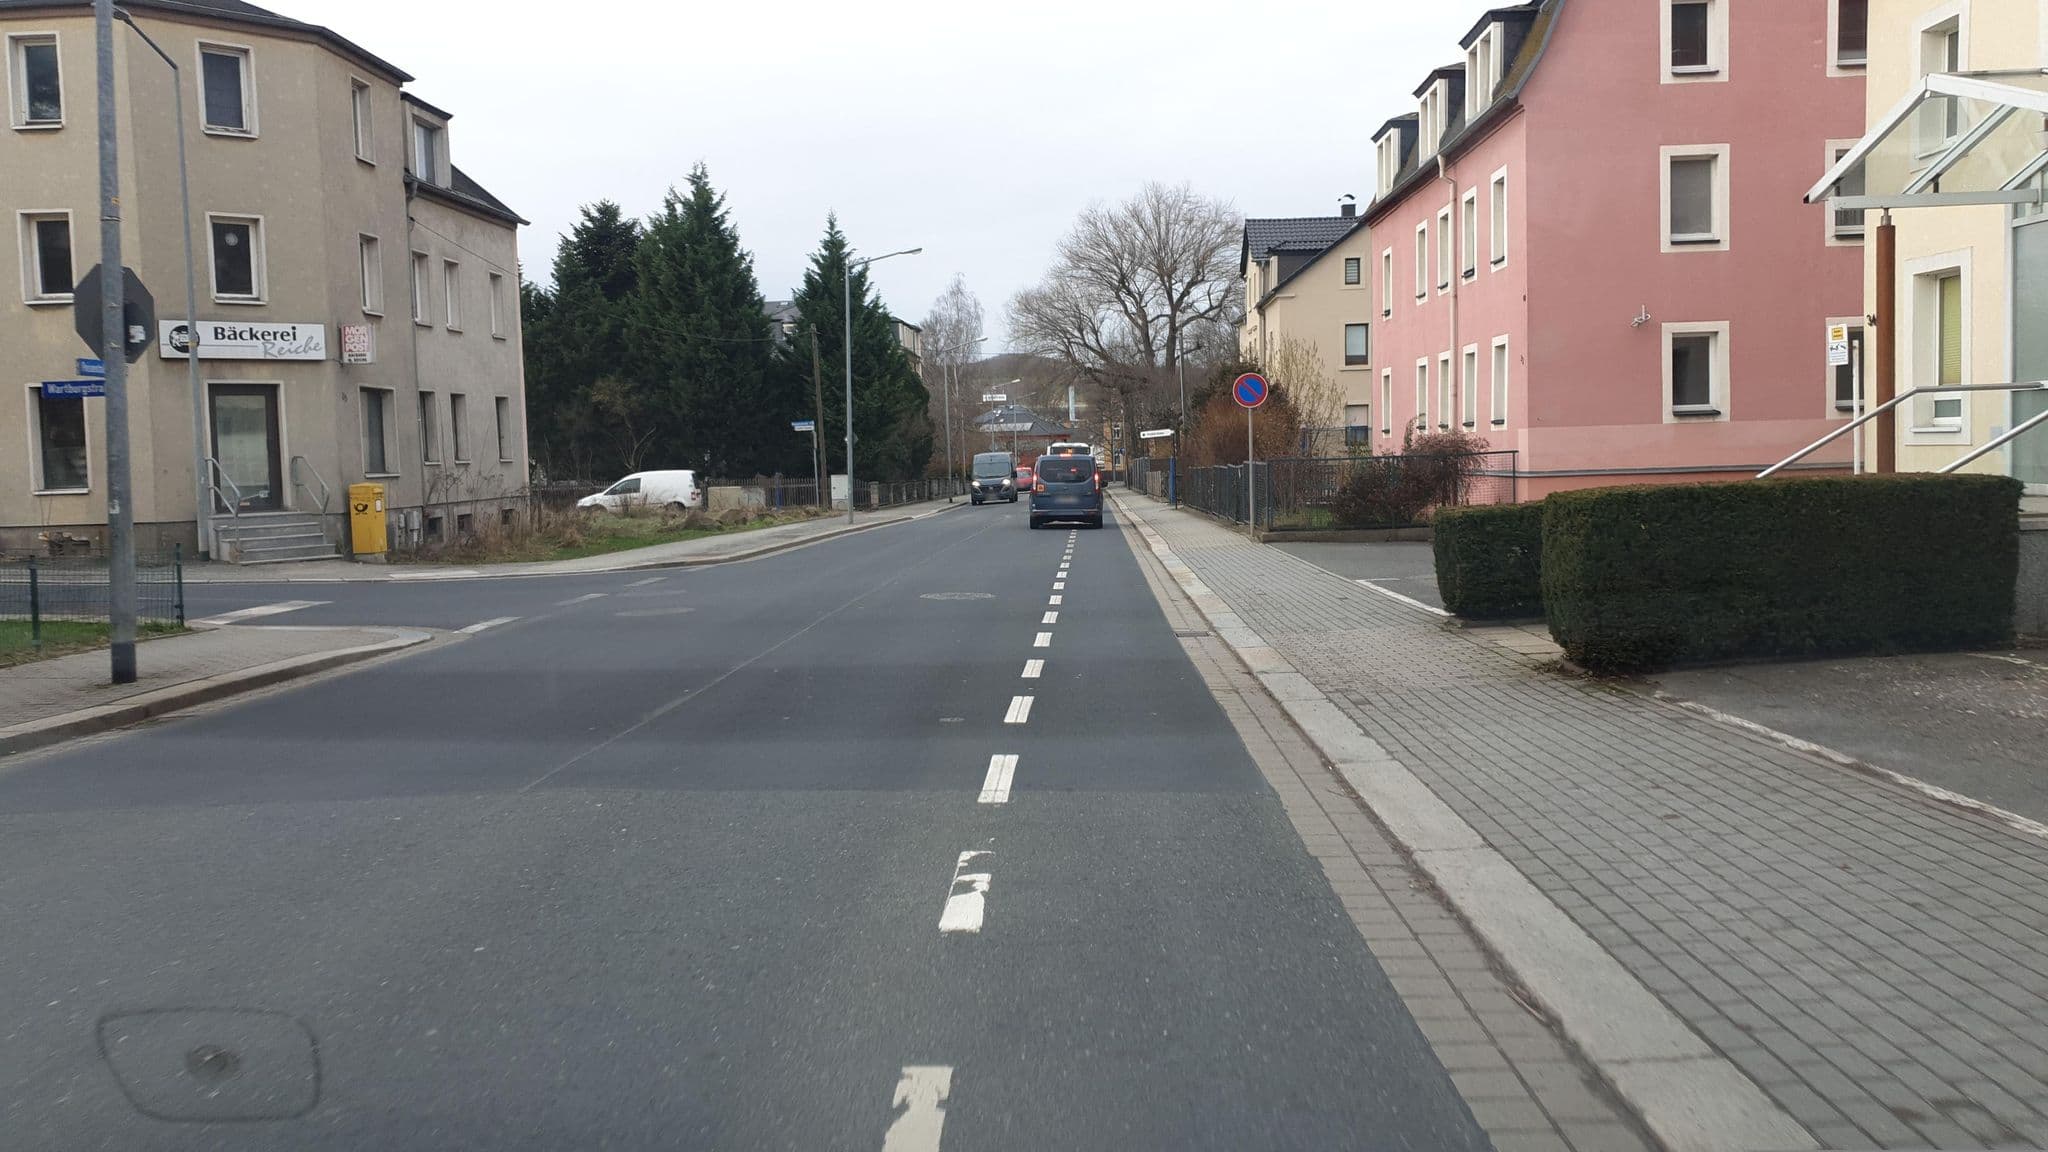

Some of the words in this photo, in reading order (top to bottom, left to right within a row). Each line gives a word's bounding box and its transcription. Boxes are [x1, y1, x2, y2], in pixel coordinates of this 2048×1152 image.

[213, 325, 297, 341] Bäckerei
[344, 326, 367, 335] MOR
[345, 333, 368, 343] GEN
[261, 336, 323, 358] Reiche
[345, 342, 368, 352] POST
[47, 383, 105, 396] Wartburgstra
